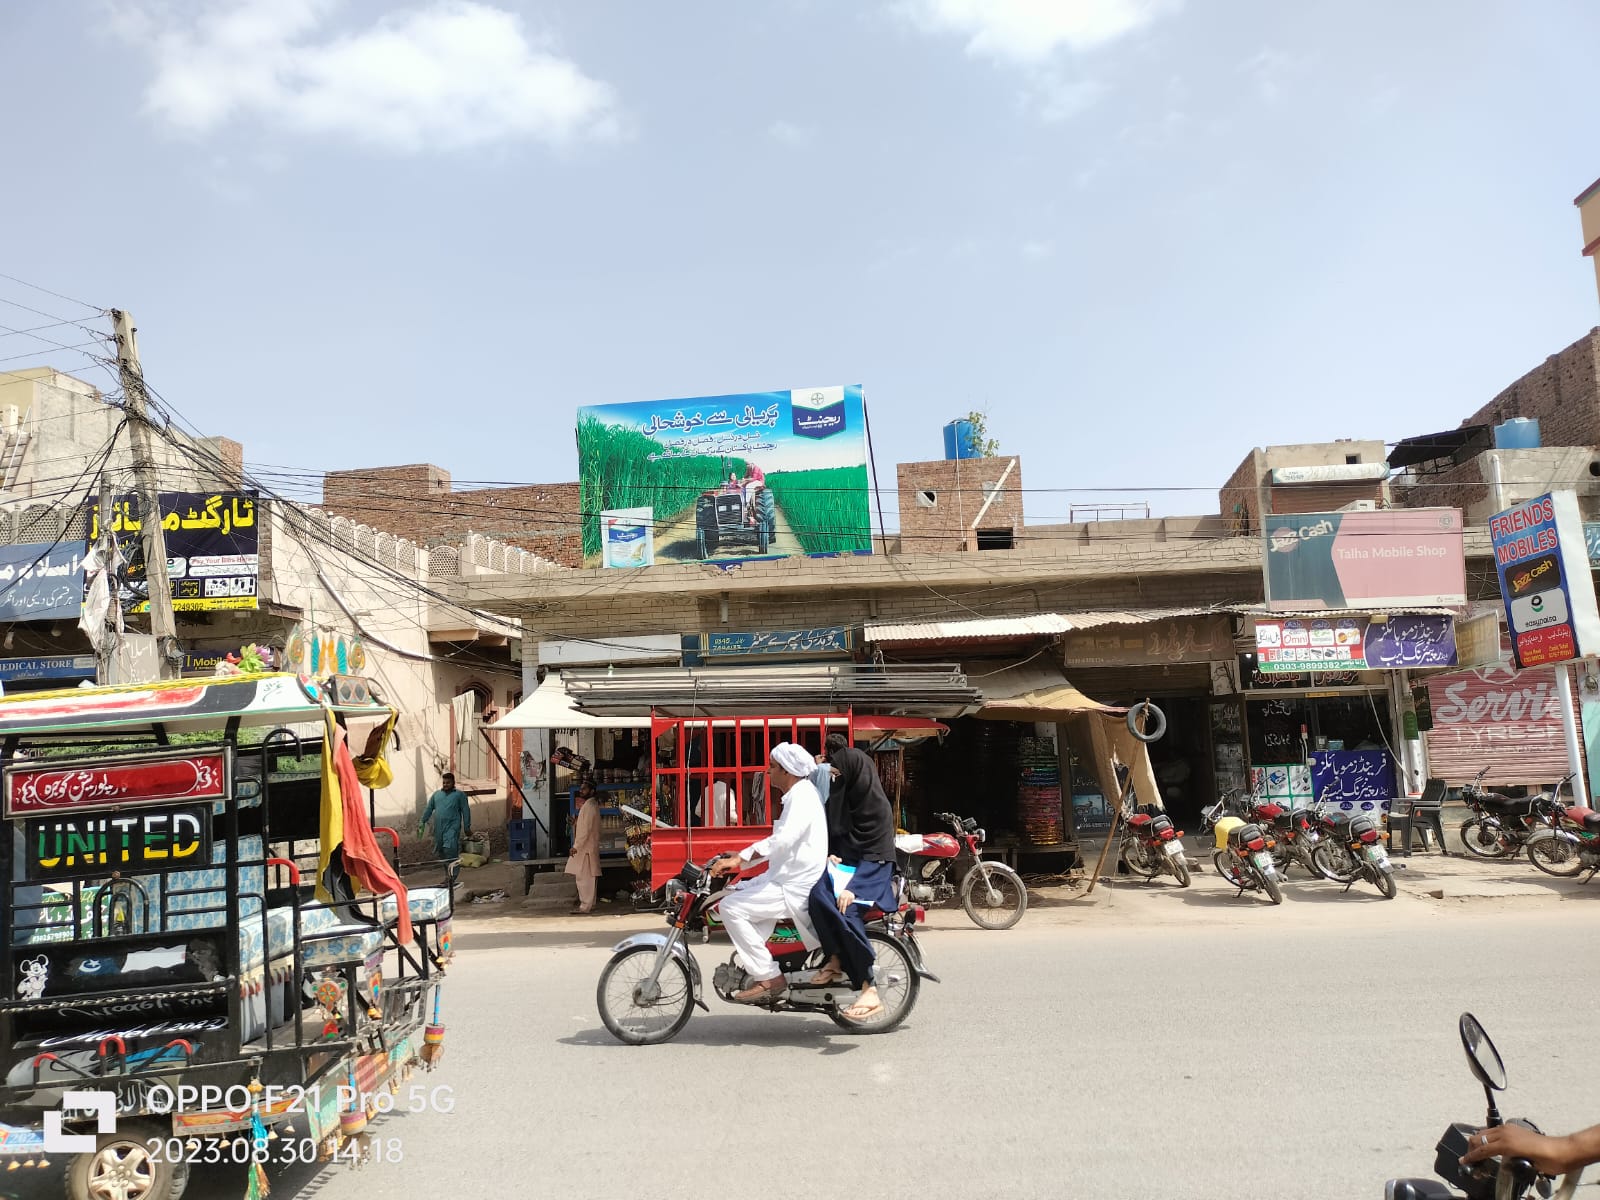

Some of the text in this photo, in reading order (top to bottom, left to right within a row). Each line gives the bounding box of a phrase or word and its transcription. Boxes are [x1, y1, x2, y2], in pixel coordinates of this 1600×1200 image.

[642, 411, 704, 436] خوشحالی
[706, 410, 733, 425] سے
[693, 436, 713, 447] فصل
[725, 443, 753, 453] پاکستان
[753, 443, 777, 451] ریجنٹ
[181, 495, 254, 535] ٹارگٹ
[1491, 498, 1553, 540] FRIENDS
[1299, 518, 1334, 541] Cash
[1338, 545, 1447, 560] Talha Mobile Shop
[1497, 527, 1557, 565] MOBILES
[18, 553, 78, 586] اسلام
[1377, 617, 1448, 646] فرینڈز موبائلز
[41, 658, 72, 669] STORE
[1380, 642, 1404, 667] لیب
[1317, 752, 1387, 776] فرینڈز موبائلز
[38, 813, 200, 868] UNITED
[39, 1021, 170, 1048] Model
